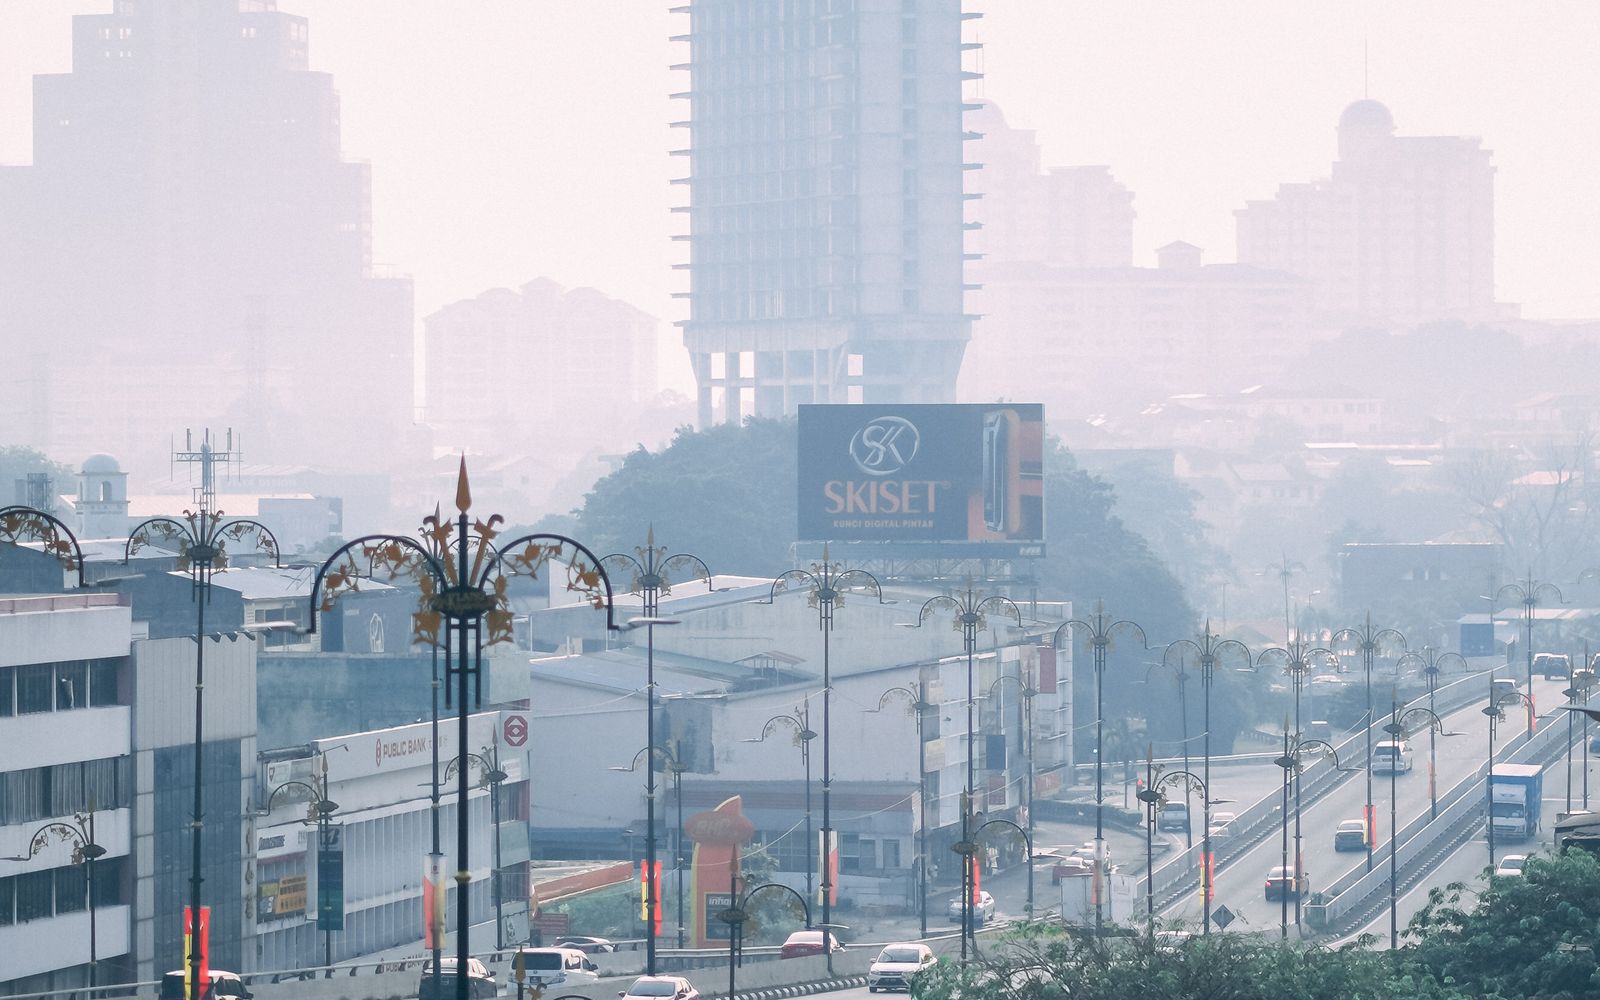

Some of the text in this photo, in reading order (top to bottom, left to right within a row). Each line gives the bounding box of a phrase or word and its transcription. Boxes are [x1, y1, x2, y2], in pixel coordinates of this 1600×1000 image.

[824, 480, 941, 513] SKISET
[833, 519, 862, 528] KUNCI
[864, 519, 901, 528] DIGITAL
[383, 741, 406, 758] PUBLIC
[408, 737, 426, 754] BANK
